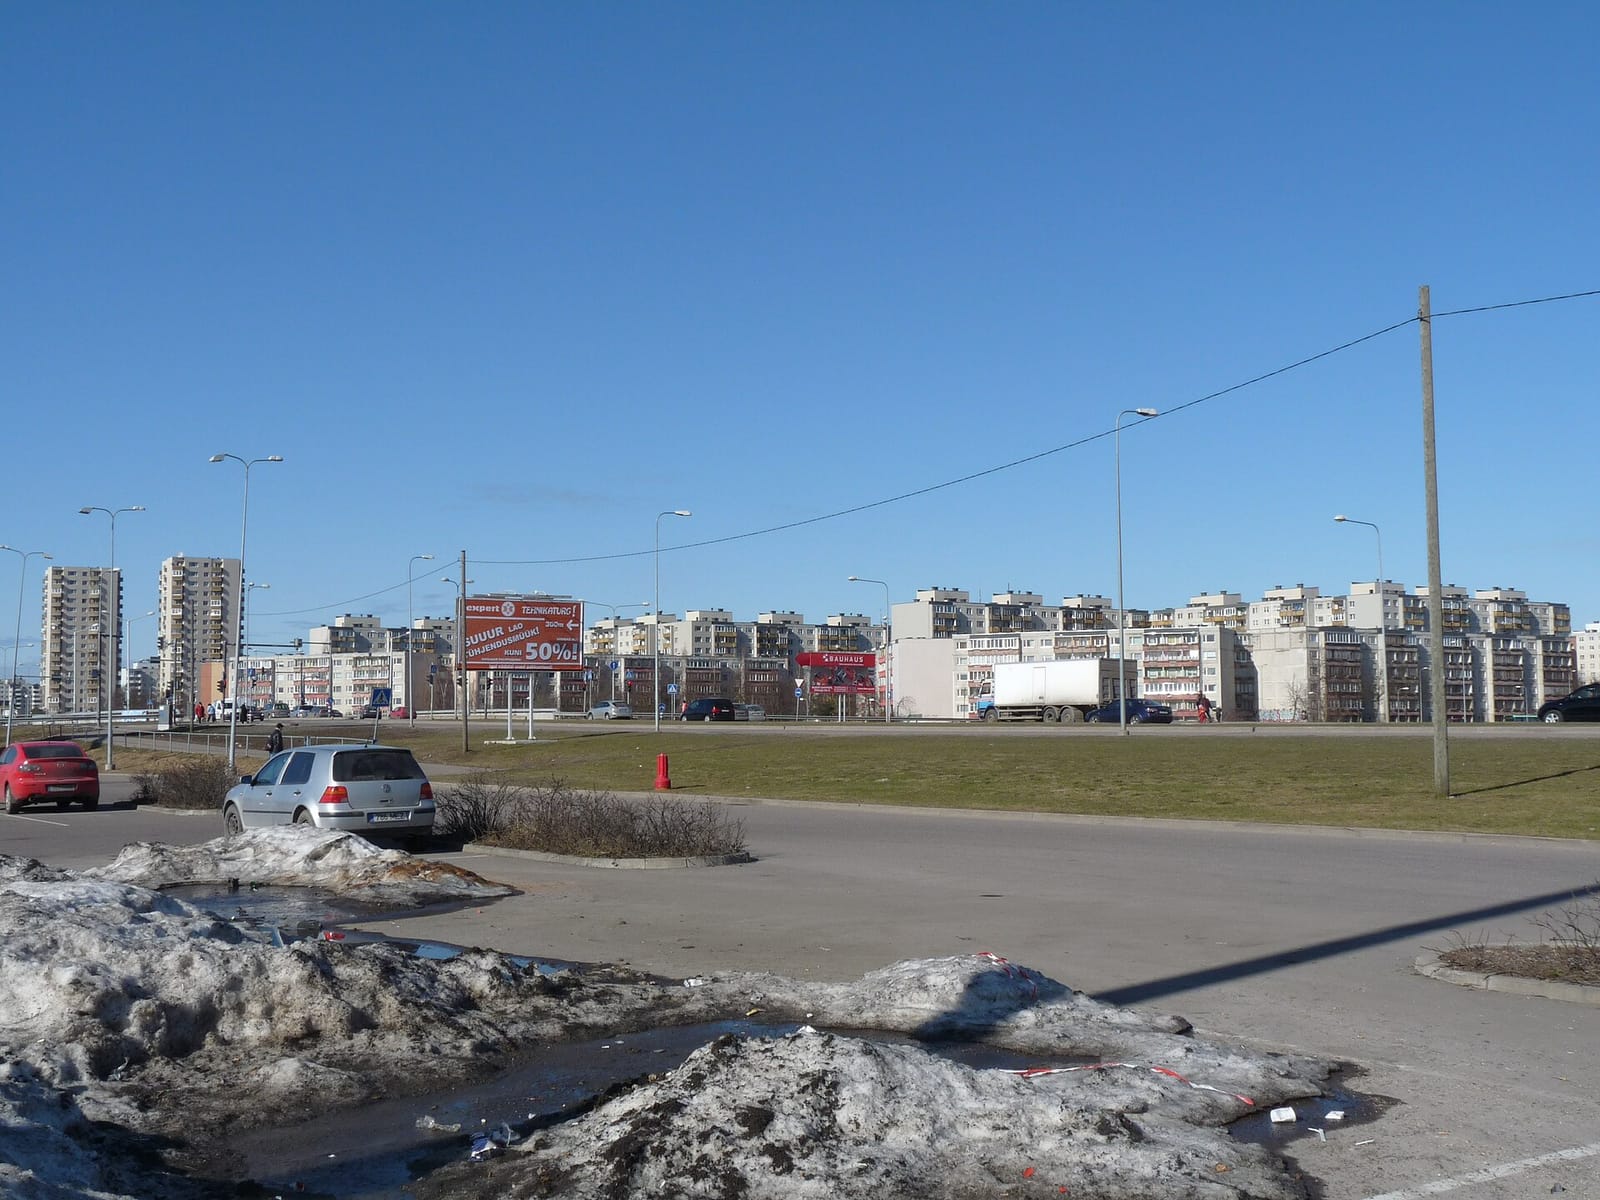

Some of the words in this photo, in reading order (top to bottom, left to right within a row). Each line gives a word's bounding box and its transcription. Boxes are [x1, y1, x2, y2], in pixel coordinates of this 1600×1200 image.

[466, 605, 500, 613] expert
[508, 622, 524, 633] LAO
[525, 642, 578, 661] 50%!
[829, 655, 864, 663] BAUHAUS
